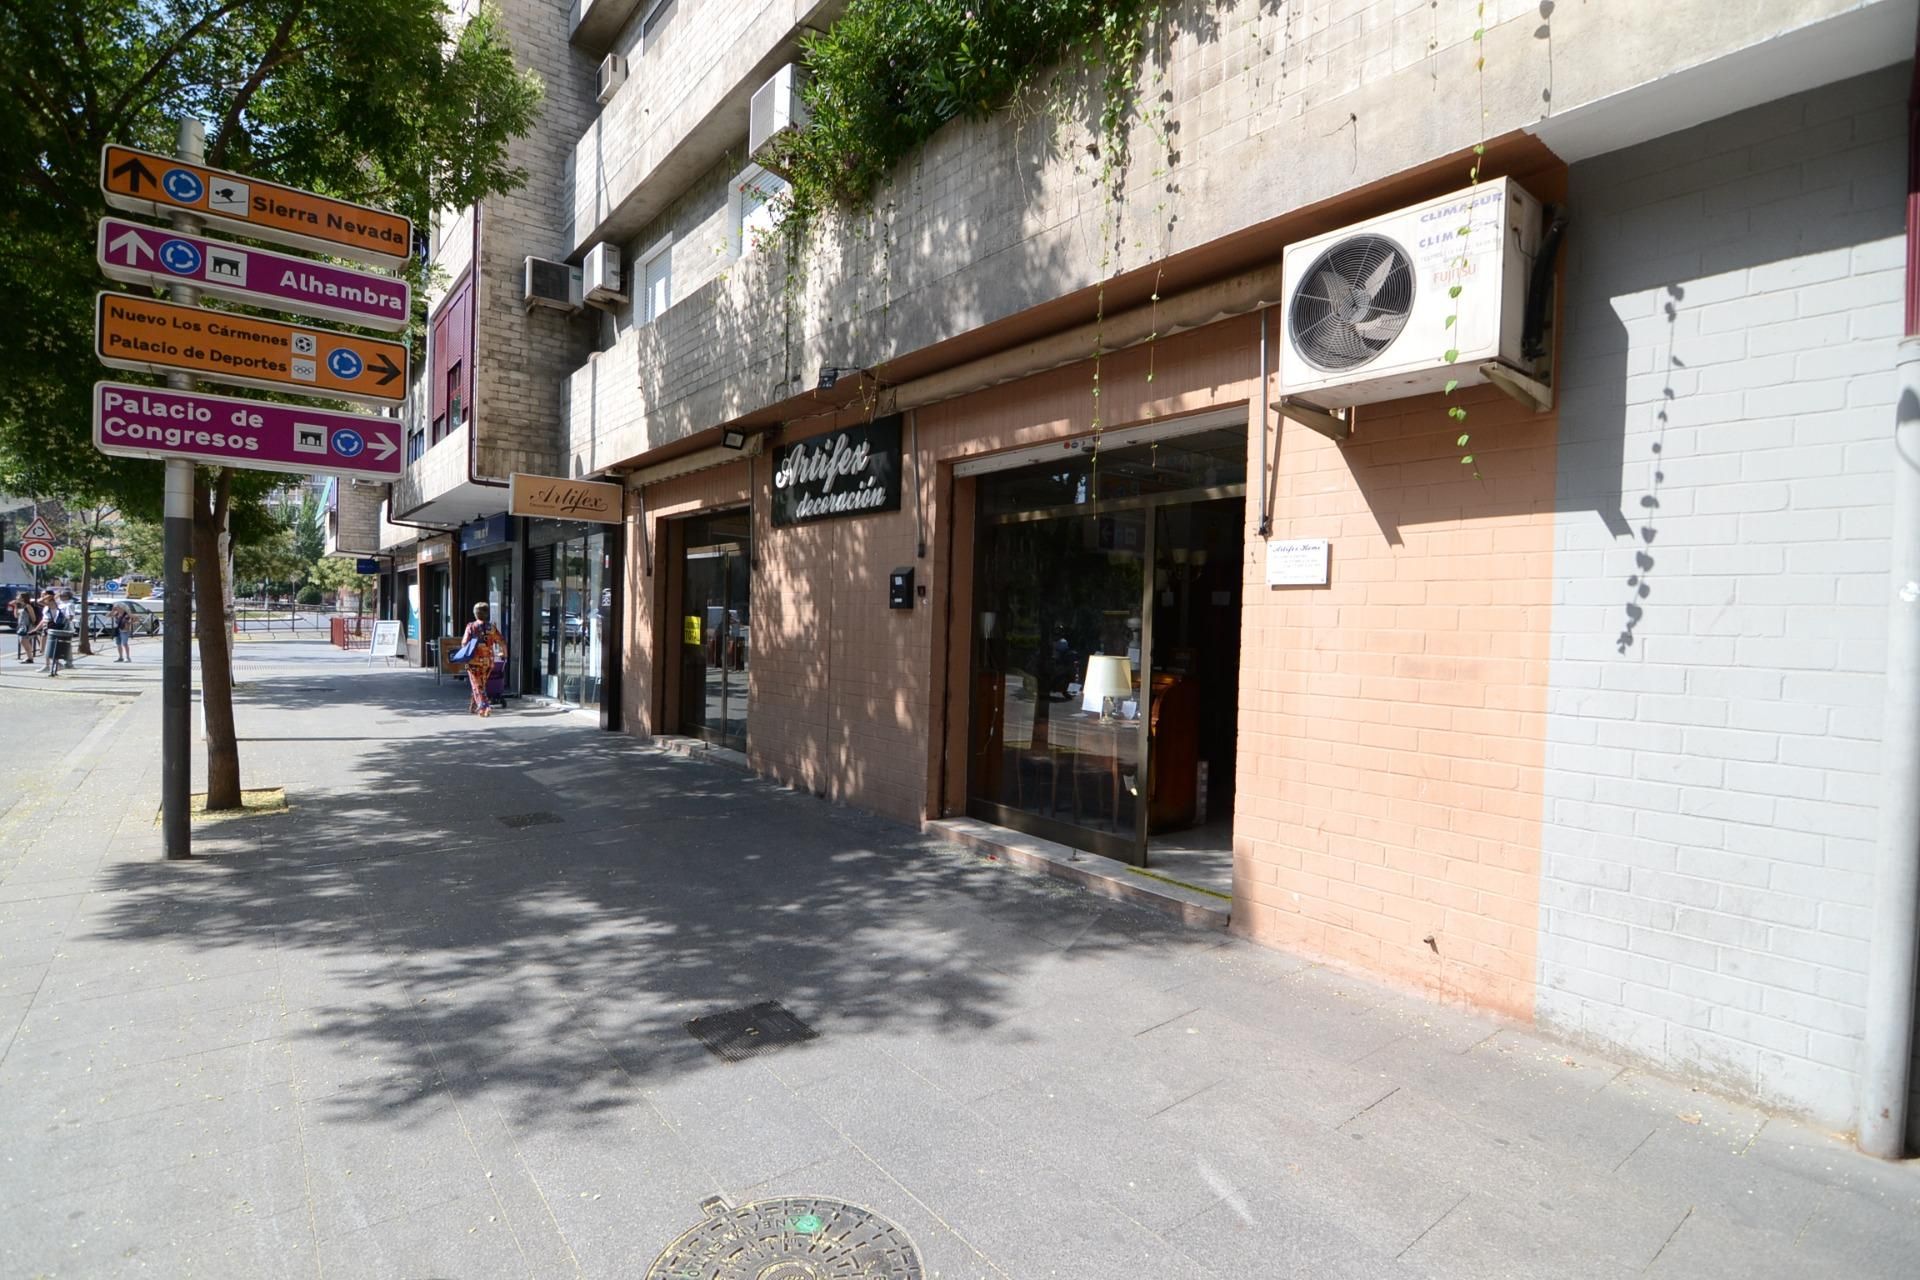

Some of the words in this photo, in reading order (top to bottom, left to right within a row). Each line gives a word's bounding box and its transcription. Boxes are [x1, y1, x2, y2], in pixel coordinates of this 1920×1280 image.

[252, 196, 319, 225] Sierra
[326, 213, 404, 245] Nevada
[279, 269, 403, 311] Alhambra
[110, 306, 168, 328] Nuevo
[172, 316, 202, 331] Los
[207, 322, 289, 348] Cármenes
[109, 333, 178, 356] Palacio
[183, 346, 205, 360] de
[209, 350, 288, 373] Deportes
[104, 391, 212, 422] Palacio
[230, 409, 264, 428] de
[104, 417, 259, 452] Congresos
[775, 432, 871, 494] Artifex
[529, 484, 609, 513] Artifex
[795, 475, 887, 518] decoración
[28, 548, 47, 558] 30
